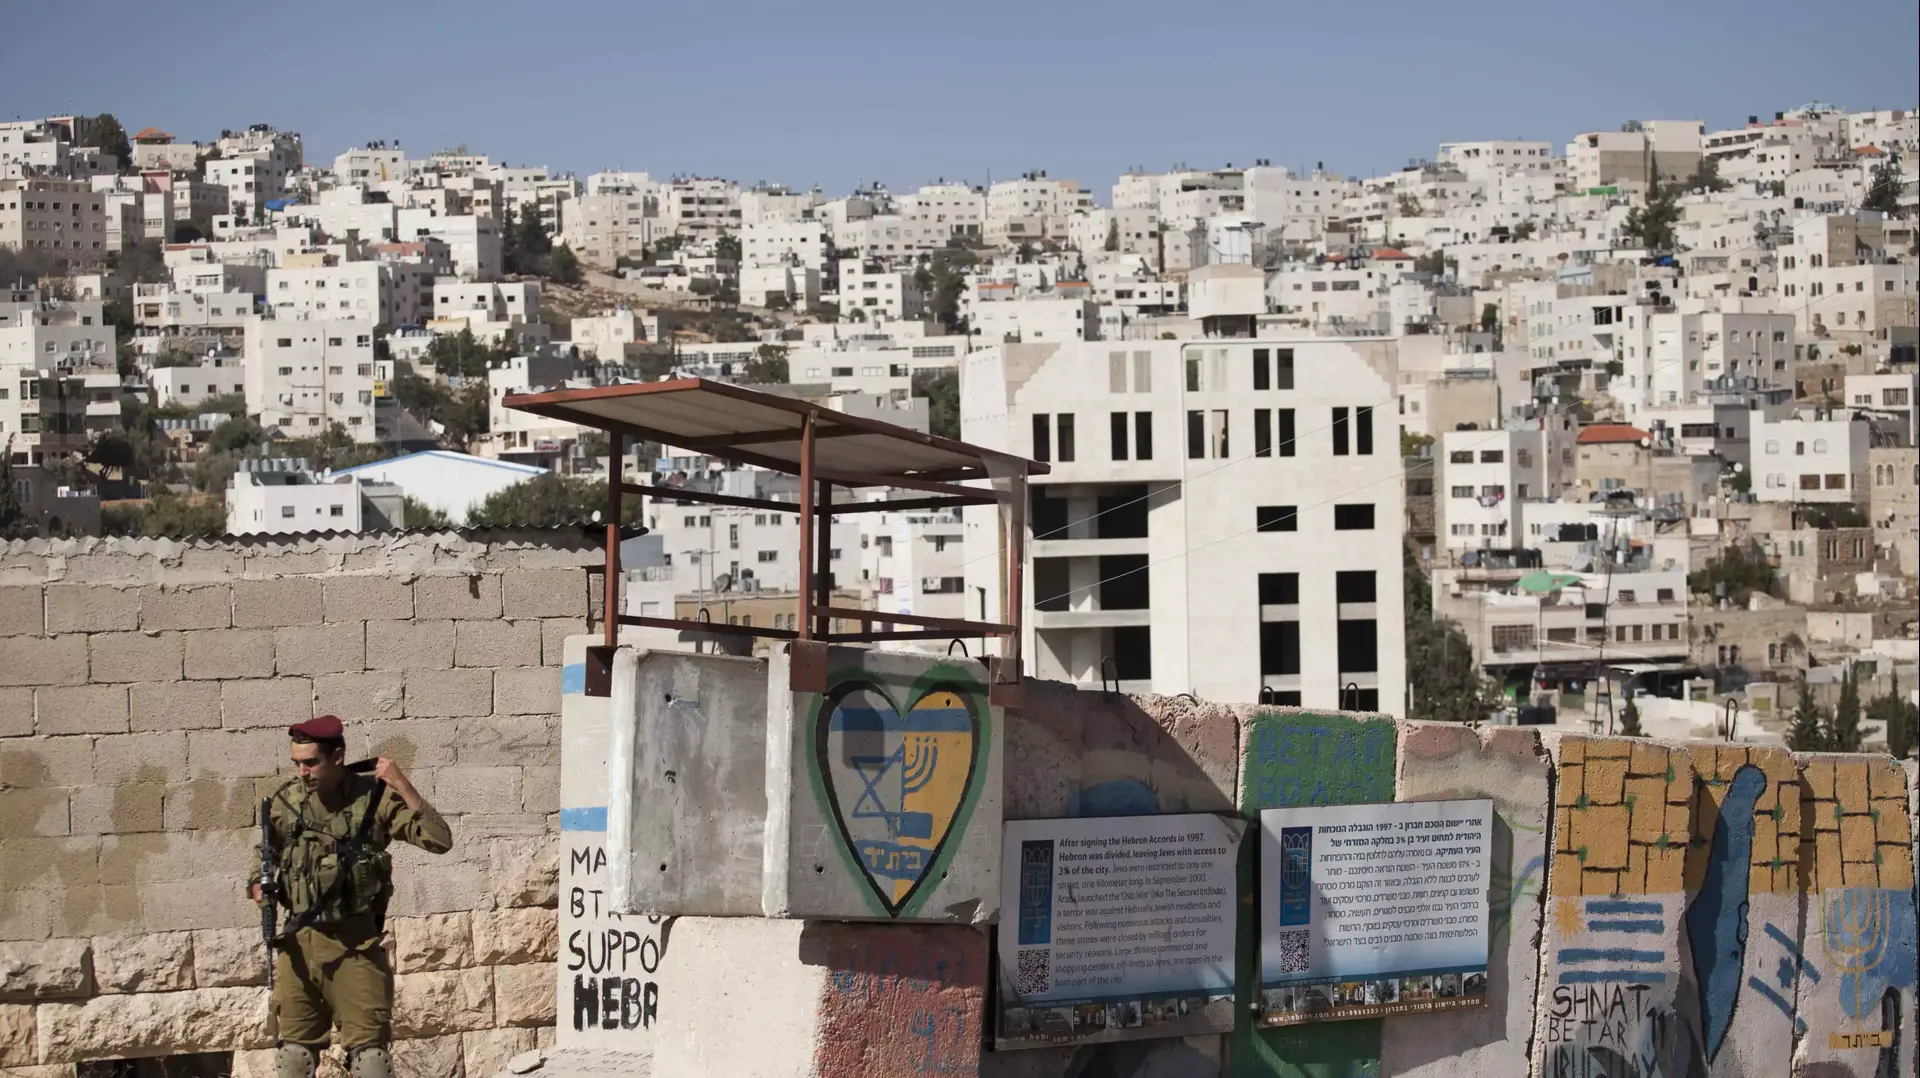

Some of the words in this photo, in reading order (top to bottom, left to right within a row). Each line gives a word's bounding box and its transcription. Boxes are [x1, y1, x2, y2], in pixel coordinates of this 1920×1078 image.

[1257, 726, 1383, 770] BETAR
[1348, 822, 1373, 832] הוגבלה
[1376, 823, 1392, 831] 1997
[1405, 821, 1423, 830] חברון
[1425, 820, 1443, 828] הסכם
[1446, 819, 1464, 827] יישום
[1466, 818, 1482, 826] אחרי
[1318, 825, 1347, 833] הנוכחות
[1060, 839, 1079, 848] After
[1080, 838, 1107, 849] signing
[1109, 837, 1121, 845] the
[1122, 836, 1148, 845] Hebron
[1149, 835, 1177, 843] Accords
[1178, 834, 1185, 842] in
[1371, 835, 1394, 846] בחלקה
[1396, 836, 1406, 844] 3%
[1408, 835, 1415, 844] בן
[1432, 832, 1454, 842] לתחום
[1455, 832, 1481, 840] היהודית
[1331, 838, 1342, 847] של
[1344, 838, 1369, 846] המזרחי
[1059, 853, 1087, 861] Hebron
[1133, 850, 1157, 860] leaving
[1159, 849, 1176, 857] Jews
[1177, 848, 1192, 856] with
[1218, 846, 1226, 854] to
[1059, 867, 1070, 875] 3%
[1072, 867, 1080, 875] of
[1081, 866, 1094, 874] the
[1113, 865, 1128, 873] Jews
[1146, 862, 1176, 871] restricted
[1178, 862, 1185, 870] to
[1186, 861, 1200, 871] only
[1096, 878, 1128, 888] kilometer
[1145, 877, 1152, 885] In
[1153, 875, 1188, 886] September
[1078, 893, 1108, 902] launched
[1108, 893, 1119, 901] the
[1151, 890, 1164, 900] (aka
[1166, 889, 1177, 897] The
[1177, 888, 1199, 897] Second
[1063, 909, 1084, 917] terror
[1100, 906, 1124, 917] against
[1125, 904, 1153, 914] Hebron's
[1154, 903, 1174, 912] Jewish
[1176, 901, 1207, 911] residents
[1208, 900, 1220, 909] and
[1085, 920, 1116, 932] Following
[1118, 920, 1148, 928] numerous
[1150, 917, 1173, 926] attacks
[1174, 916, 1186, 924] and
[1056, 937, 1075, 946] these
[1077, 935, 1099, 944] stores
[1118, 933, 1138, 942] closed
[1139, 932, 1146, 942] by
[1173, 929, 1195, 938] orders
[1196, 928, 1207, 936] for
[567, 929, 660, 974] SUPPO
[1055, 950, 1083, 962] security
[1158, 943, 1194, 953] commercial
[1194, 942, 1208, 950] and
[1055, 964, 1087, 975] shopping
[1146, 959, 1154, 967] to
[1186, 958, 1203, 966] open
[1204, 955, 1211, 963] in
[1212, 954, 1223, 963] the
[1055, 979, 1071, 987] Arab
[1072, 978, 1087, 988] part
[1088, 977, 1096, 985] of
[1097, 977, 1108, 985] the
[573, 973, 659, 1032] HEBR
[1410, 1002, 1432, 1010] היהודי
[1551, 982, 1651, 1025] SHNAT
[1385, 1005, 1408, 1013] בחברון
[1548, 1016, 1629, 1051] BETAR
